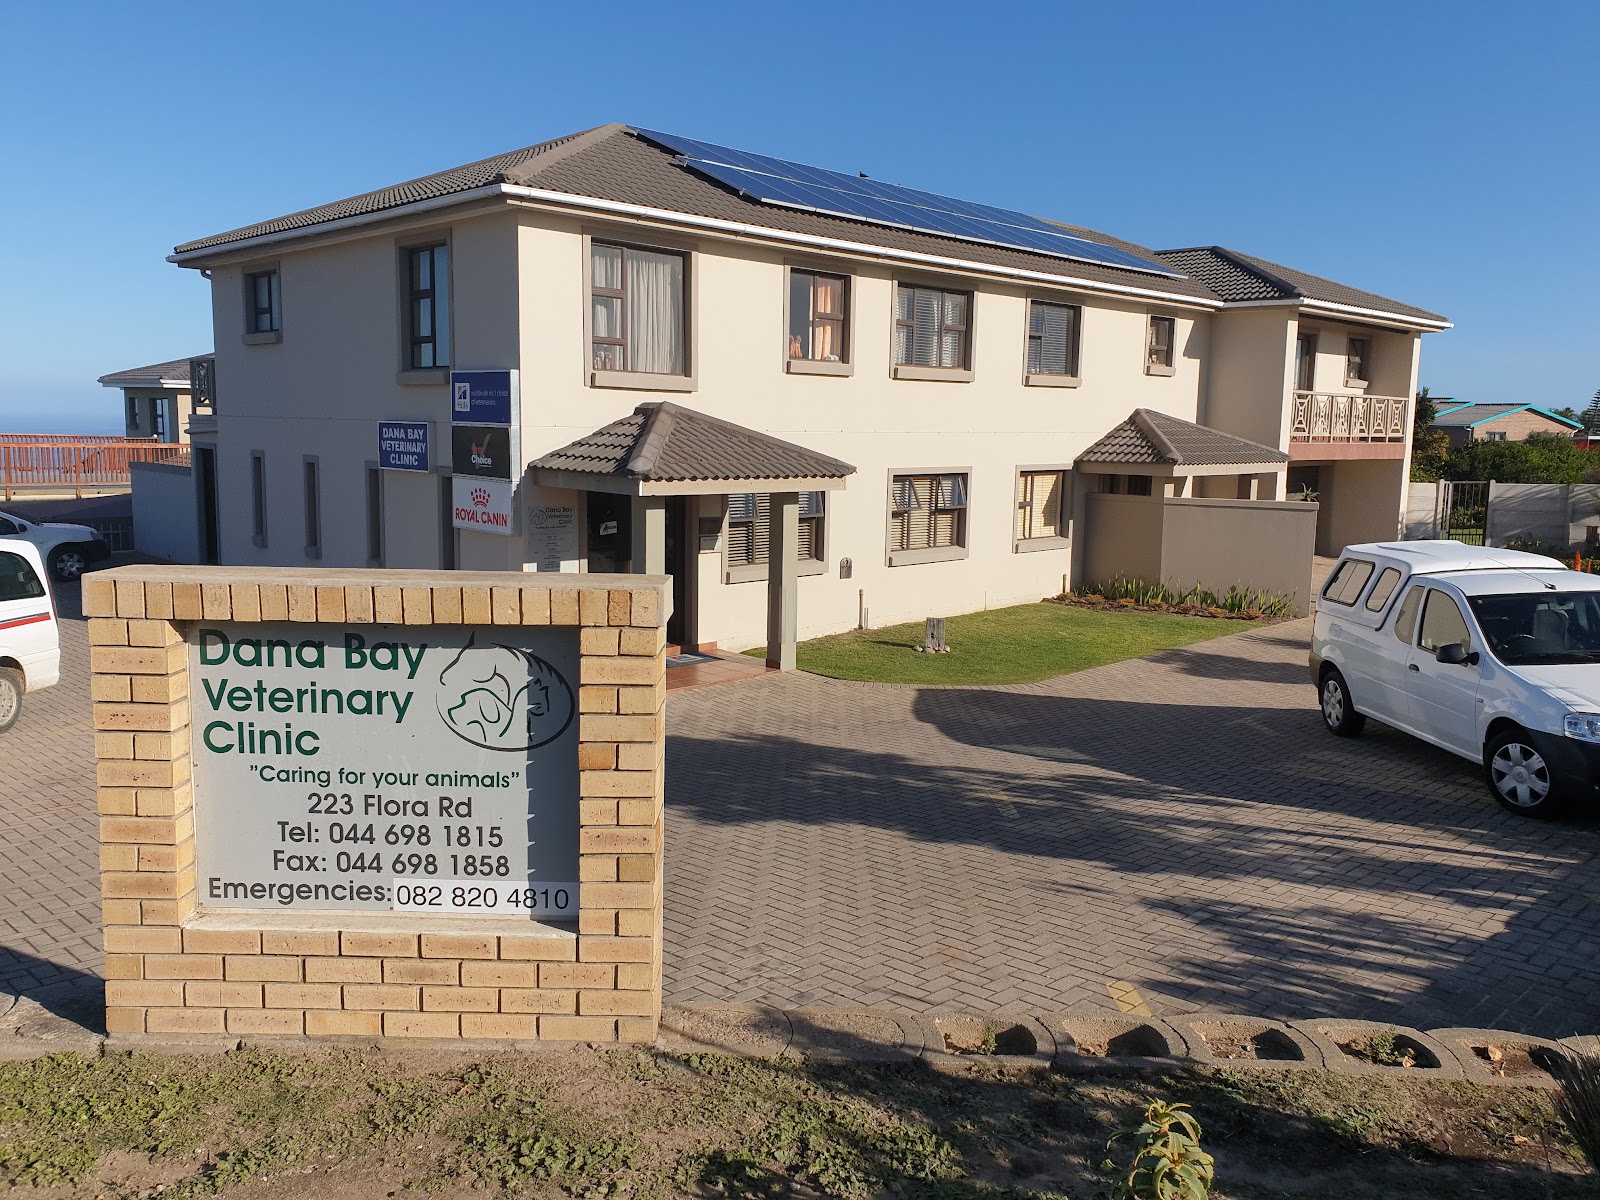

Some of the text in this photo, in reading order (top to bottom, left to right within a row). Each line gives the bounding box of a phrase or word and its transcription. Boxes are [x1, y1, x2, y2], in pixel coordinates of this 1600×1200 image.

[381, 440, 427, 453] VETERINARY
[382, 427, 425, 440] DANA BAY
[390, 453, 419, 466] CLINIC
[471, 454, 492, 465] Choice
[455, 507, 508, 527] ROYAL CANIN
[199, 628, 428, 680] Dana Bay
[201, 677, 414, 724] Veterinary
[202, 720, 321, 756] Clinic
[337, 767, 368, 785] for
[373, 771, 419, 789] your
[307, 792, 472, 819] 223 Flora Rd
[276, 820, 504, 848] Tel: 044 698 1815
[273, 849, 510, 877] Fax: 044 698 1858
[208, 877, 569, 910] Emergencies: 082 820 4810
